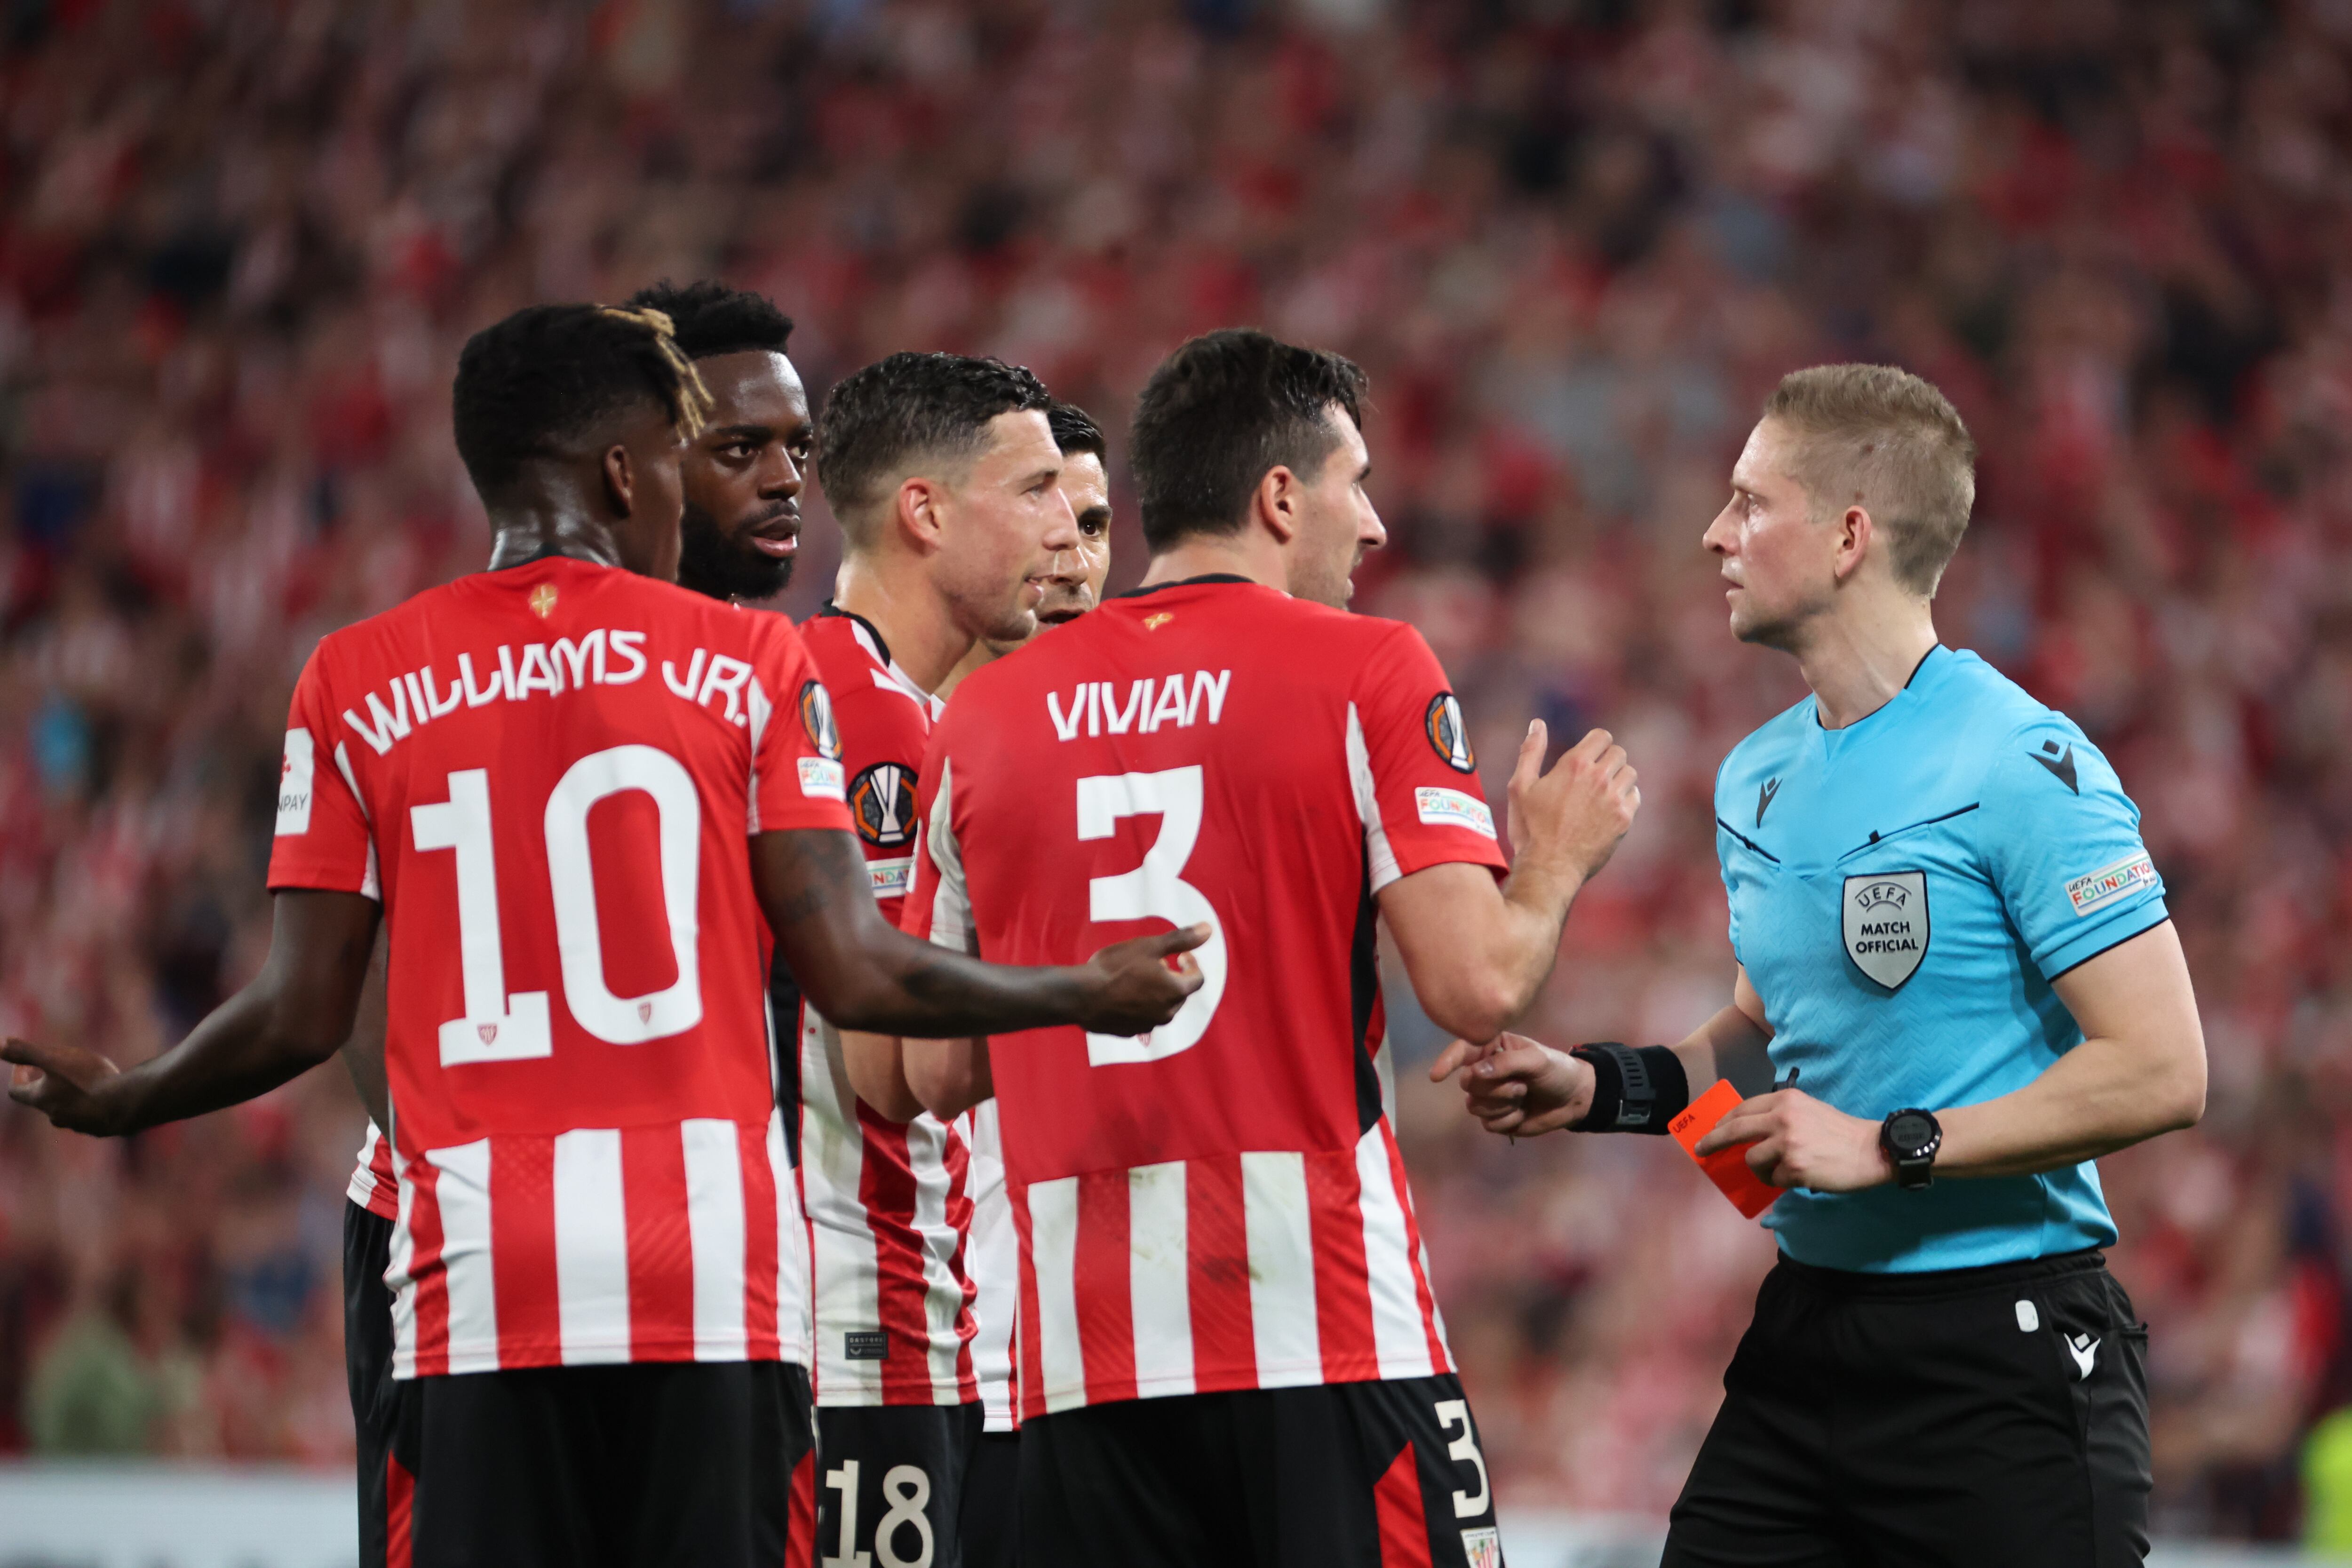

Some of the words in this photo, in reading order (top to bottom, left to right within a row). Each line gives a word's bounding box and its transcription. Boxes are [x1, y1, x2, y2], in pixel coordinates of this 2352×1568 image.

[343, 629, 646, 756] WILLIAMS
[661, 647, 751, 726] JR.
[1047, 669, 1231, 741] VIVIAN
[410, 744, 703, 1068] 10
[1076, 764, 1228, 1067] 3
[1859, 887, 1906, 907] UEFA
[2069, 876, 2092, 892] UEFA
[1855, 938, 1919, 954] OFFICIAL
[1861, 921, 1910, 936] MATCH
[1673, 1113, 1696, 1133] UEFA
[1434, 1399, 1490, 1519] 3
[822, 1459, 934, 1568] 18
